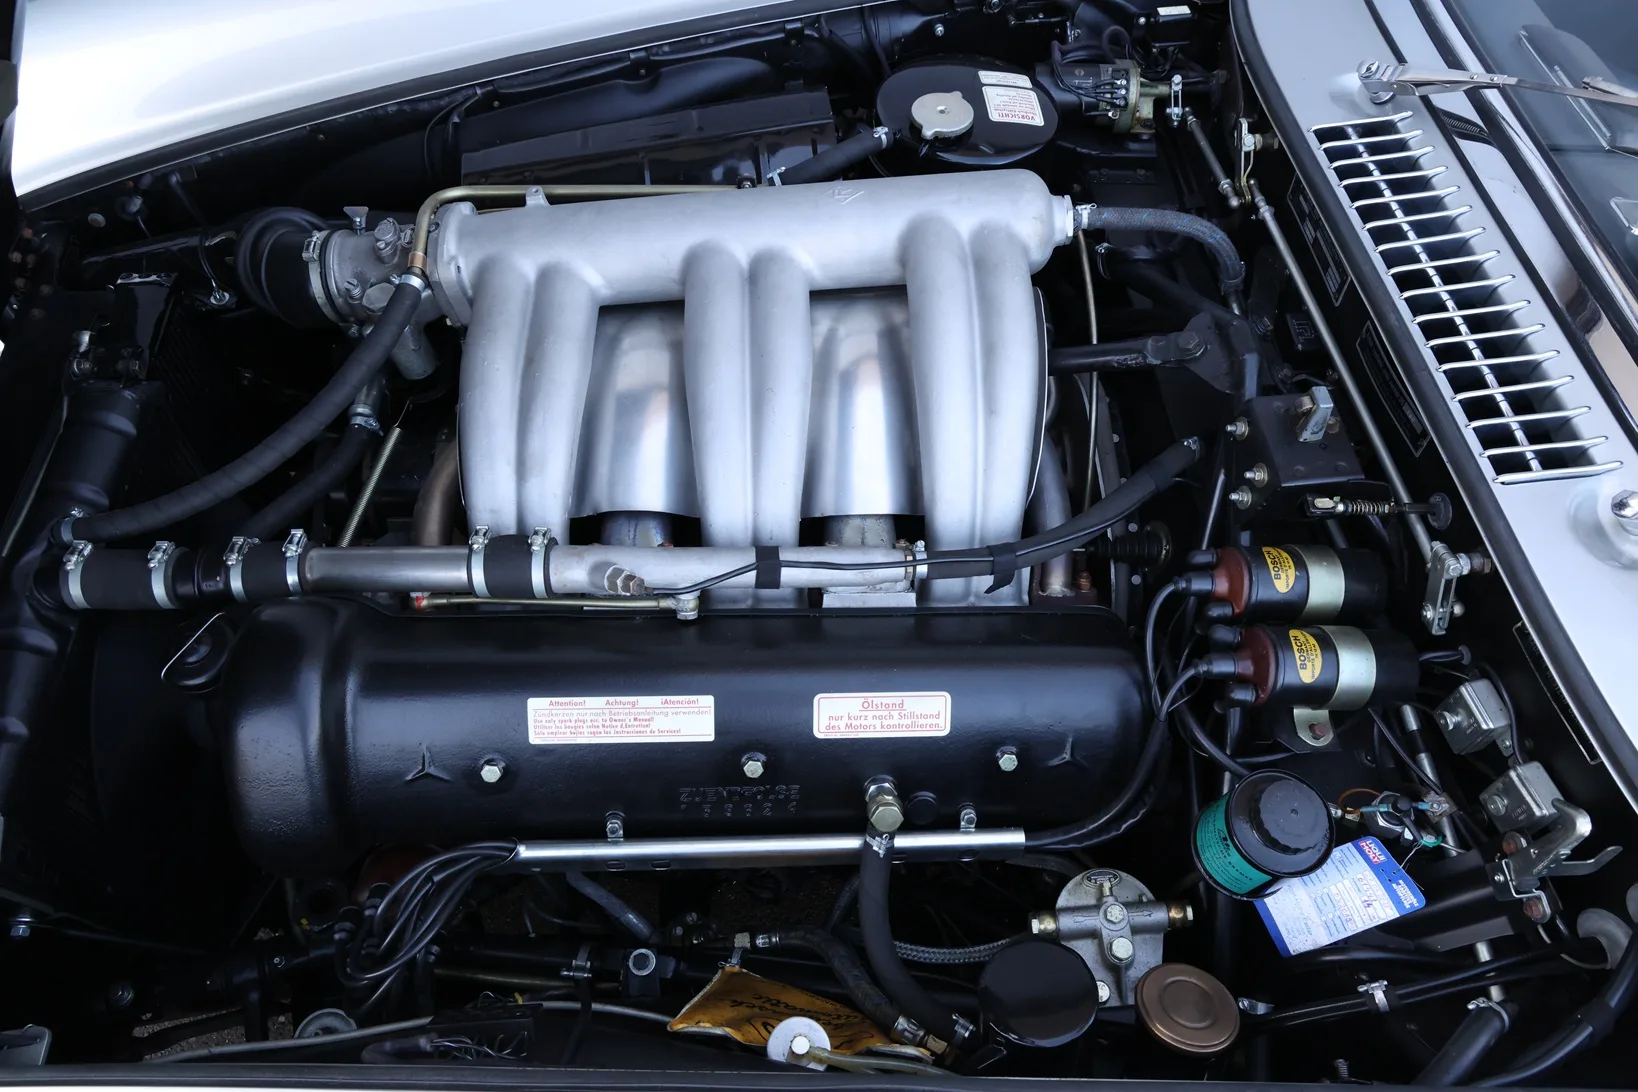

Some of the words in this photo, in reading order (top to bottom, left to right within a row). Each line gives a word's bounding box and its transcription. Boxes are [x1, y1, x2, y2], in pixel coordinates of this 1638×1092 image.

[998, 112, 1036, 121] VORSICHT!
[1264, 550, 1281, 579] BOSCH
[1291, 635, 1306, 669] BOSCH
[605, 699, 639, 708] Achtung!
[862, 696, 904, 710] Ölstand
[608, 708, 669, 718] Betriebsanleitung
[847, 712, 869, 721] kurz
[872, 712, 894, 720] nach
[897, 710, 941, 720] Stillstand
[825, 722, 841, 730] des
[844, 721, 877, 730] Motors
[880, 720, 943, 730] kontrollieren.
[1360, 842, 1379, 863] MOLY
[1366, 839, 1386, 861] LIQUI
